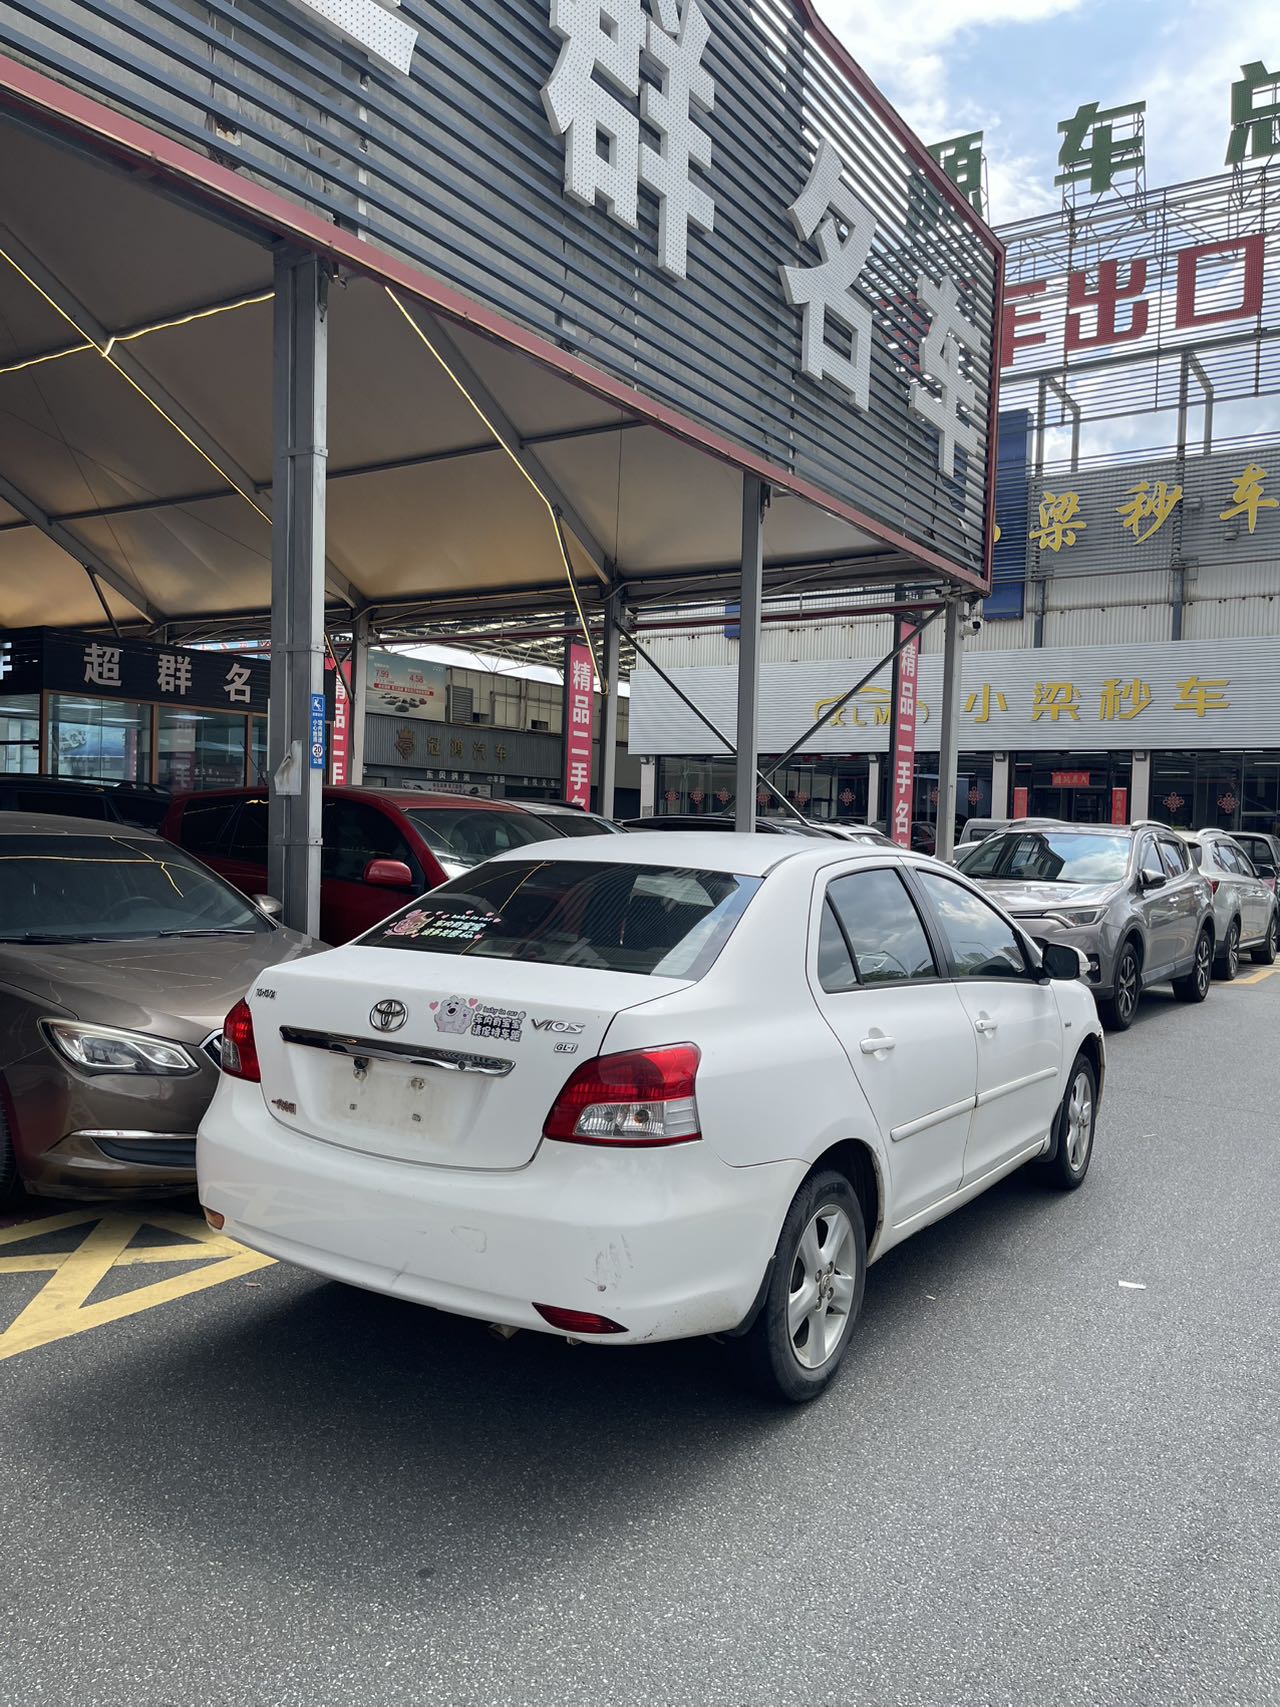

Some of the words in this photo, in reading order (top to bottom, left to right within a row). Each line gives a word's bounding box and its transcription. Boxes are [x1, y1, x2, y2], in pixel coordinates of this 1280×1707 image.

[287, 0, 984, 478] 群名车
[993, 463, 1279, 552] 梁秒车
[964, 675, 1231, 723] 小梁秒车
[895, 643, 916, 849] 精品二手名
[474, 1014, 522, 1029] 车内有宝宝
[532, 1019, 585, 1034] VIOS
[555, 1043, 576, 1052] GL-i
